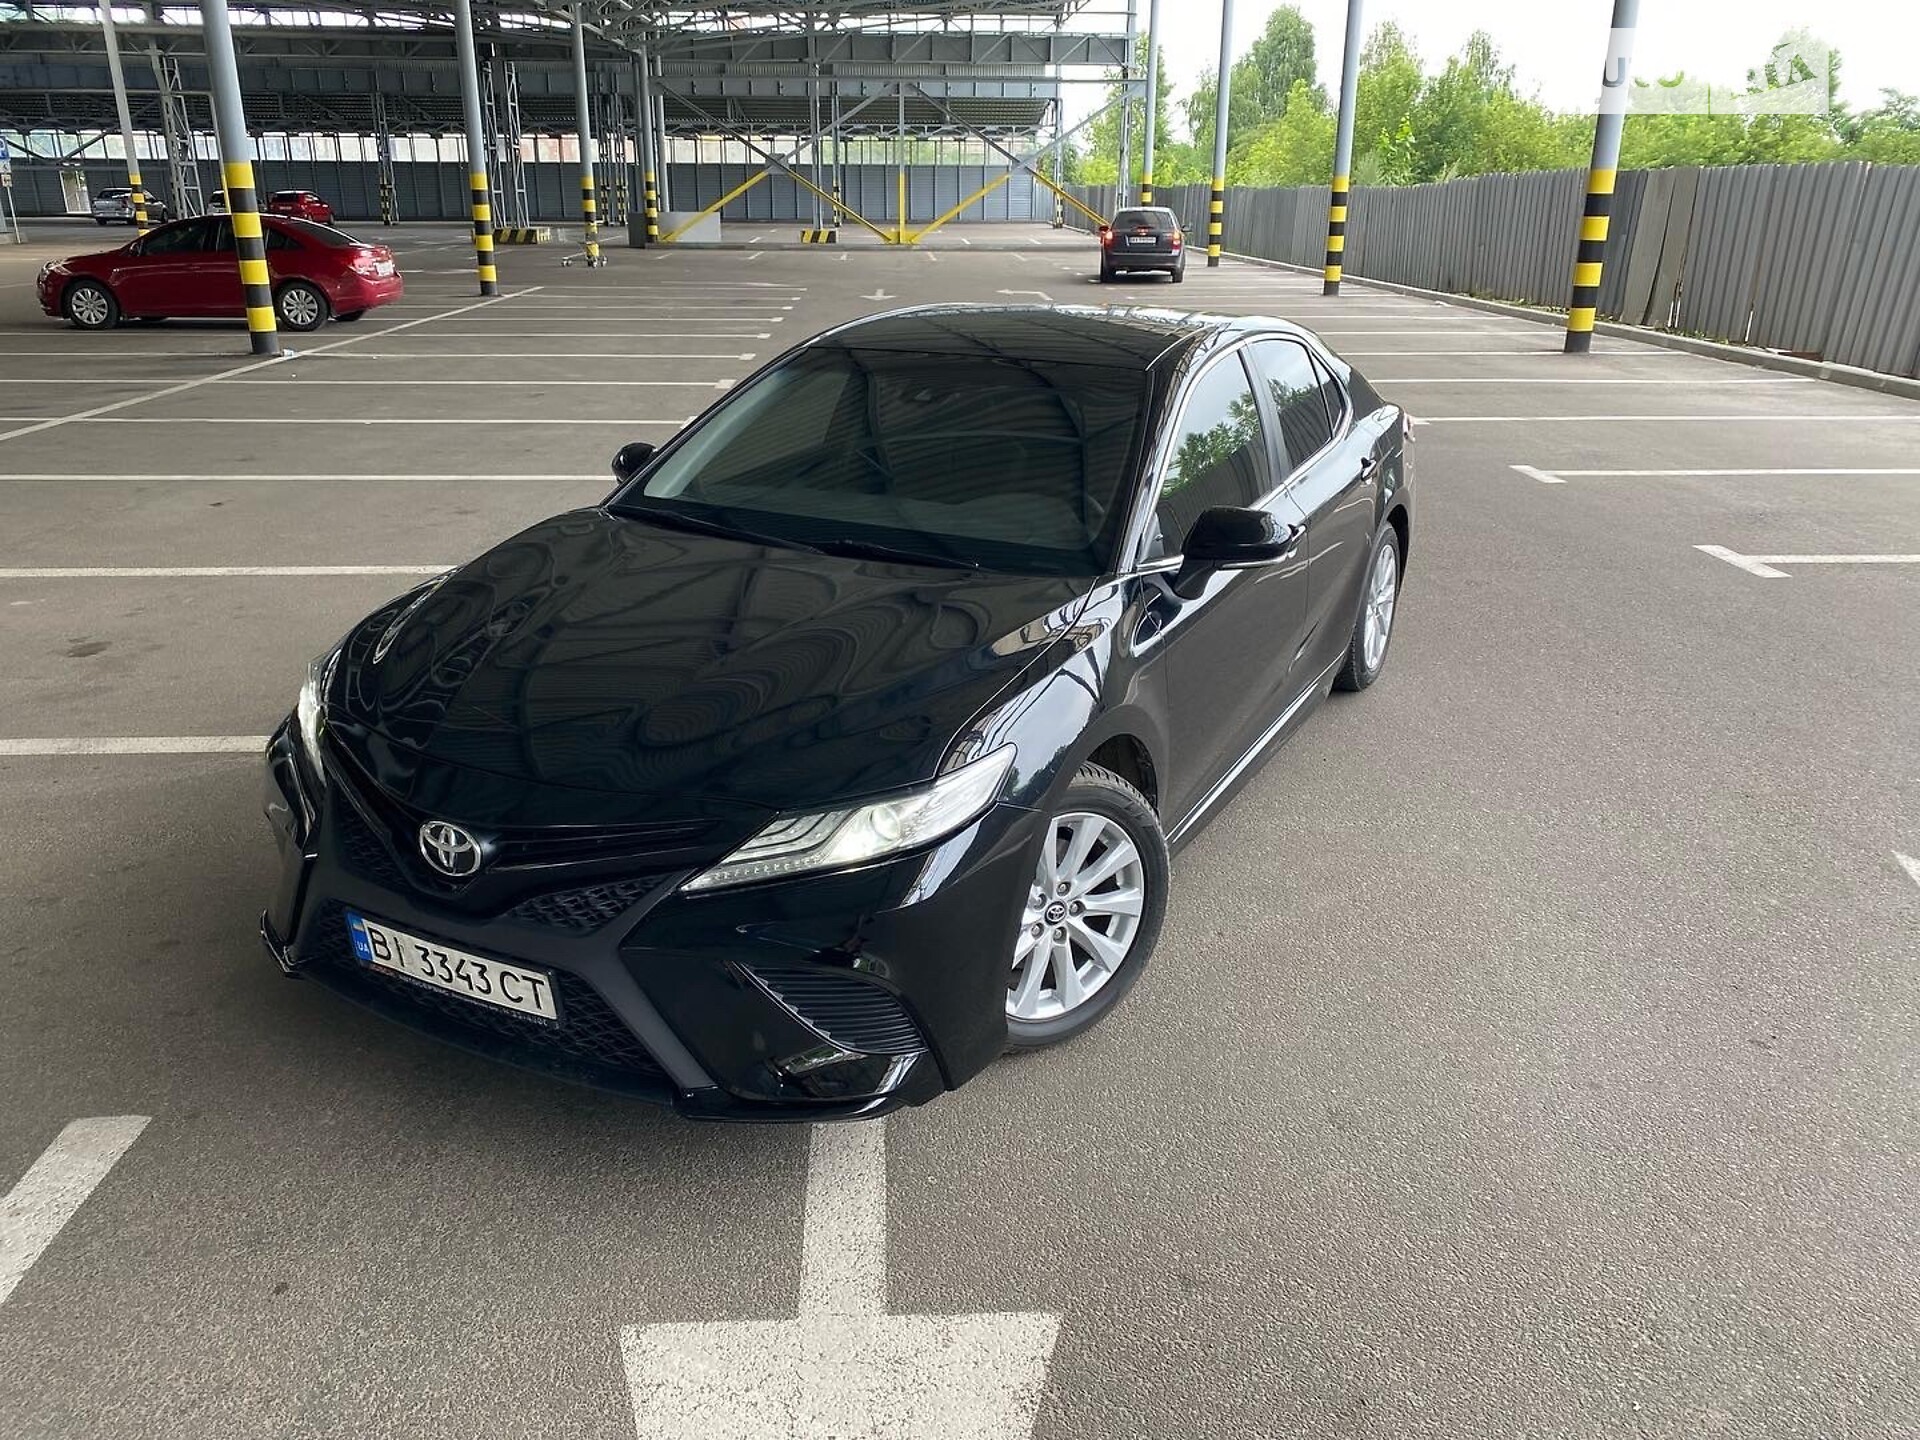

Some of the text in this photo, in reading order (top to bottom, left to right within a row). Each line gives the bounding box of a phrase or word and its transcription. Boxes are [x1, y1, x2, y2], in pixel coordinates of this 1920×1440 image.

[356, 941, 371, 954] UA
[367, 927, 405, 968] BI
[415, 944, 492, 995] 3343
[499, 971, 546, 1010] CT
